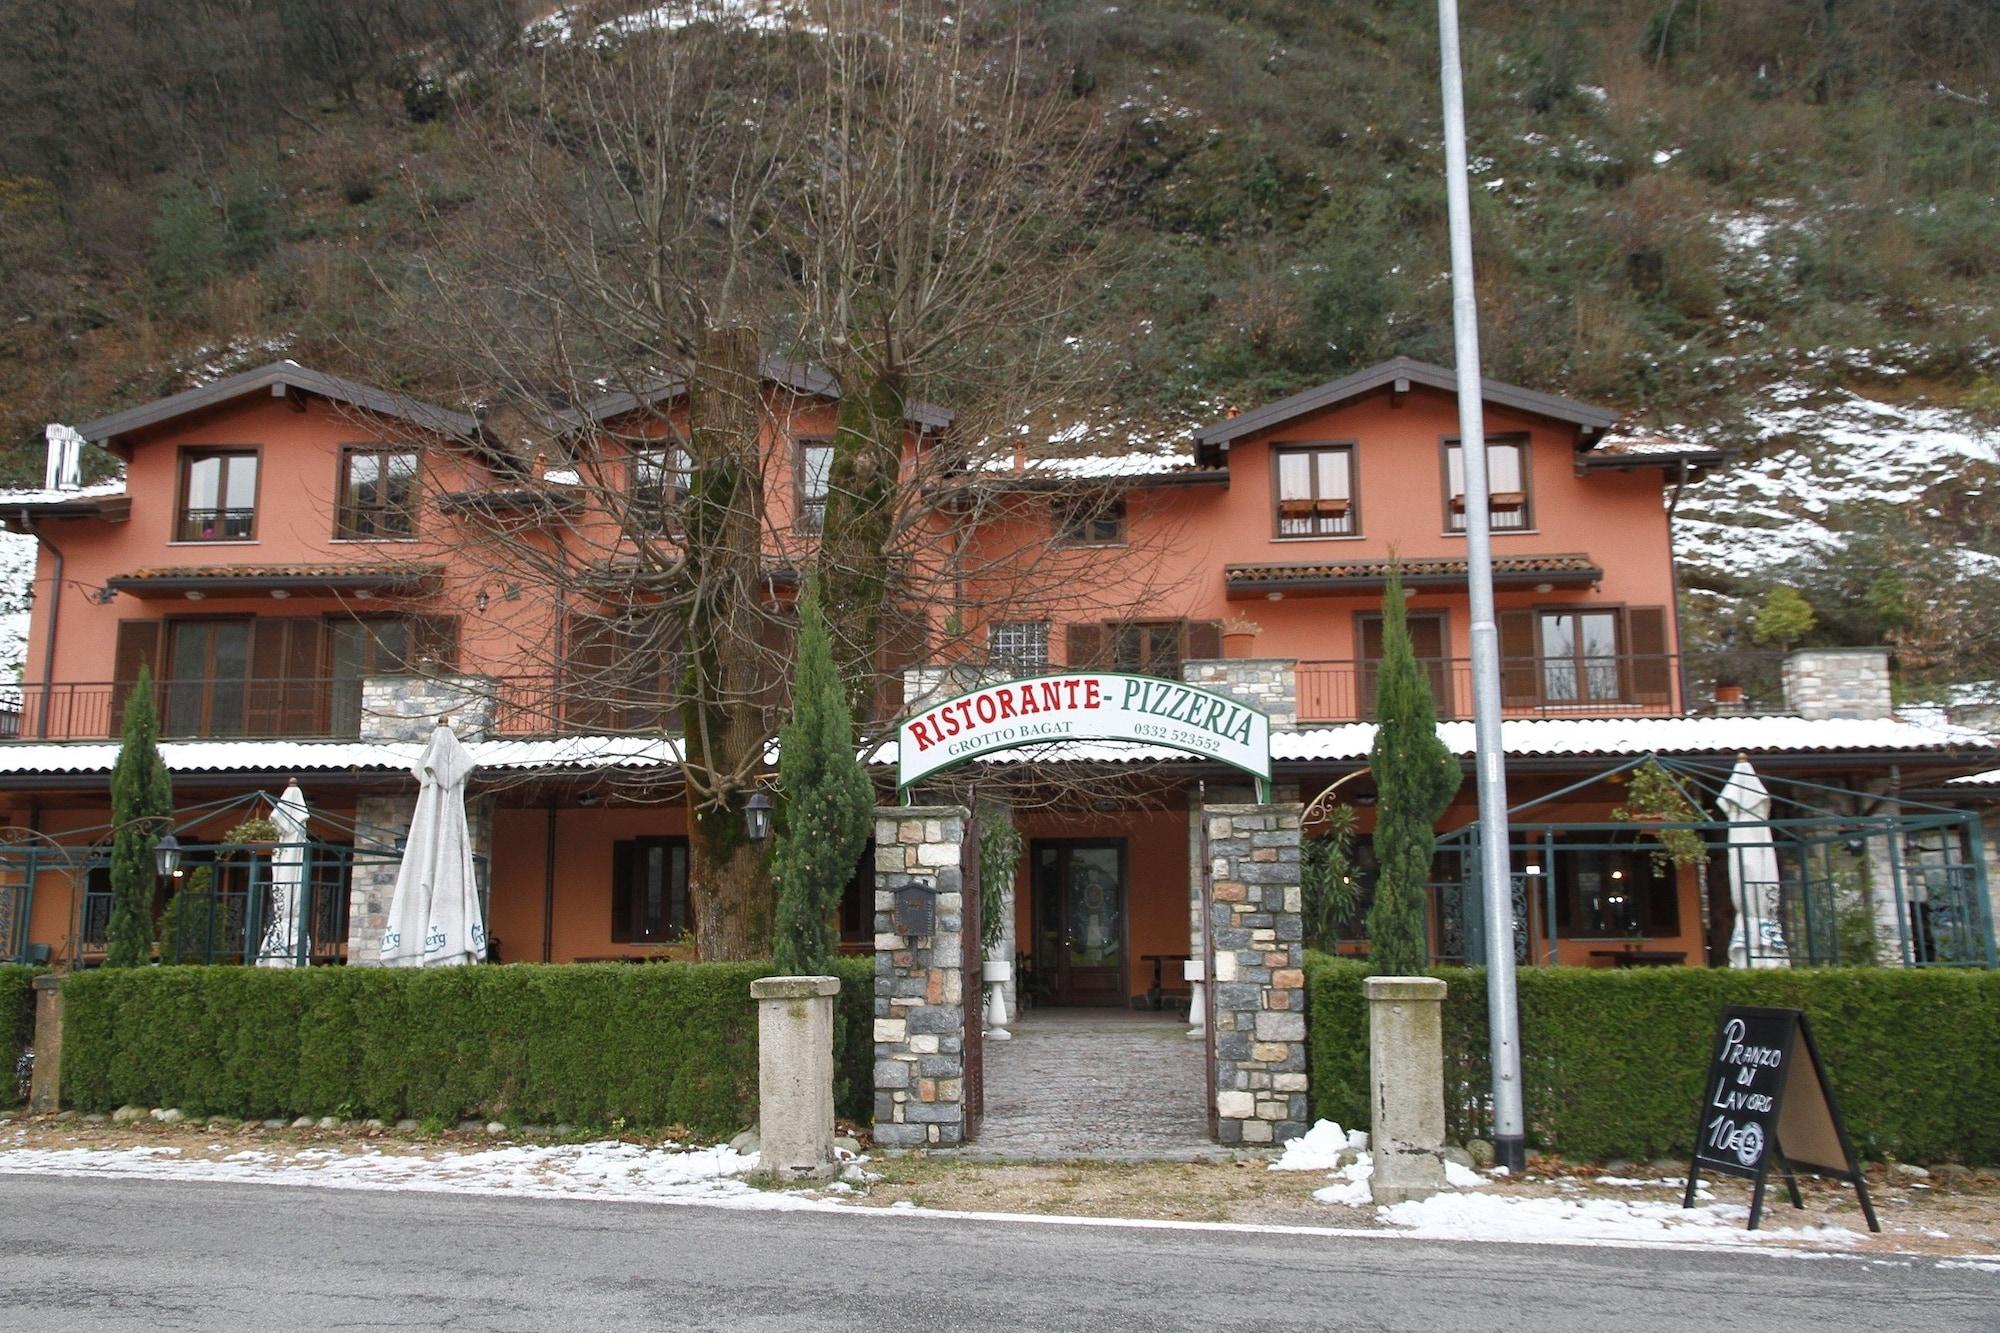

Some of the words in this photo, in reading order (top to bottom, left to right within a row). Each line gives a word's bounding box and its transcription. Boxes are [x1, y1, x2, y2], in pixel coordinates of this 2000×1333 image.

[1120, 679, 1253, 746] PIZZERIA
[948, 728, 1015, 756] GROTTO
[1019, 721, 1073, 738] BAGAT
[1134, 723, 1168, 739] 0332
[1170, 730, 1221, 752] 523552
[1720, 1018, 1782, 1068] PRANZO
